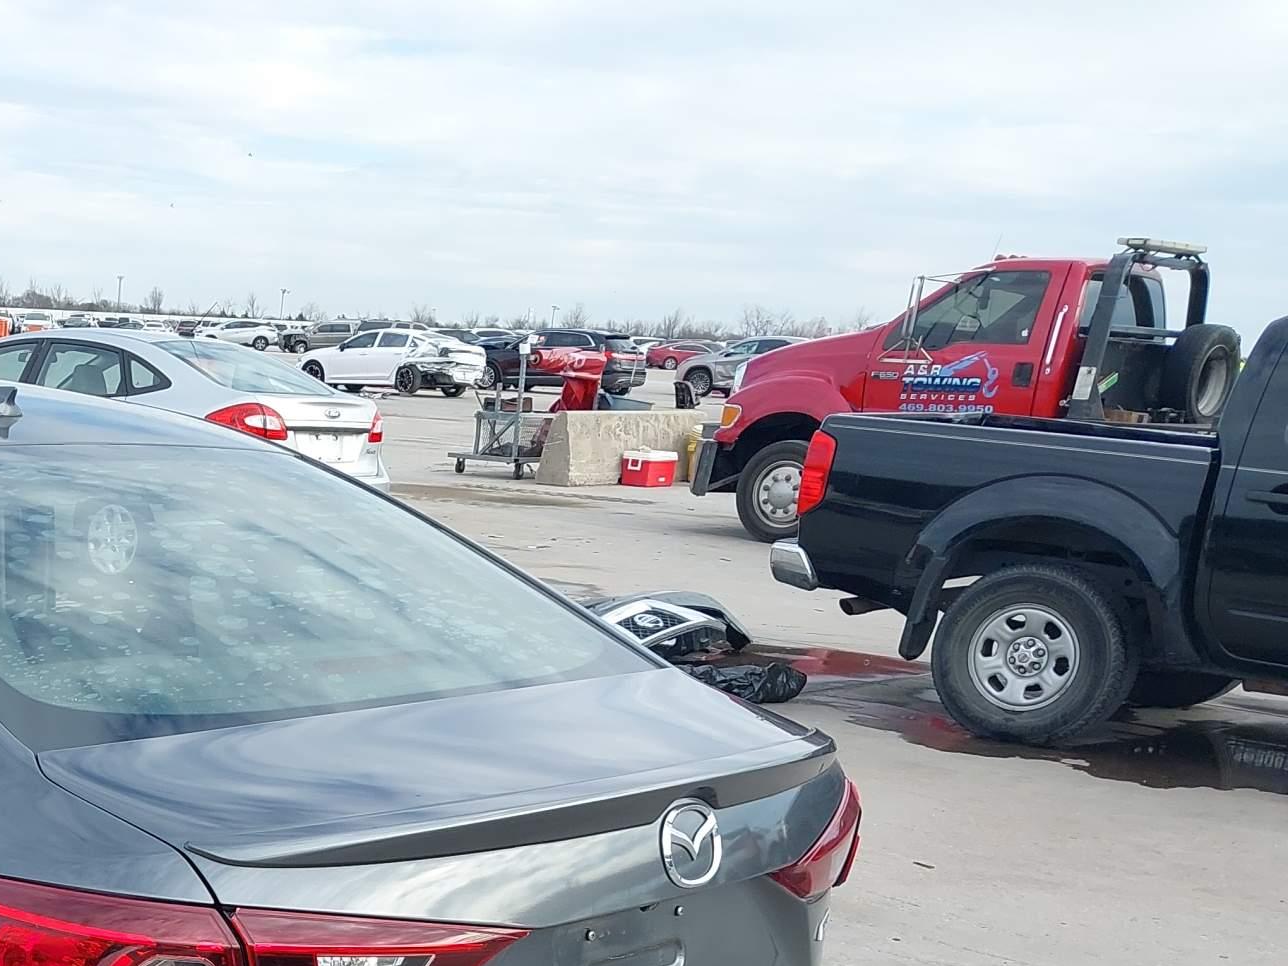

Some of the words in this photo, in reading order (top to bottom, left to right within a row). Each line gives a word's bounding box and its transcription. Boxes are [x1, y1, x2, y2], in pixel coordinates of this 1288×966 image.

[901, 376, 982, 392] TOWING
[900, 393, 976, 401] SERVICES
[899, 402, 994, 414] 469.803.9950
